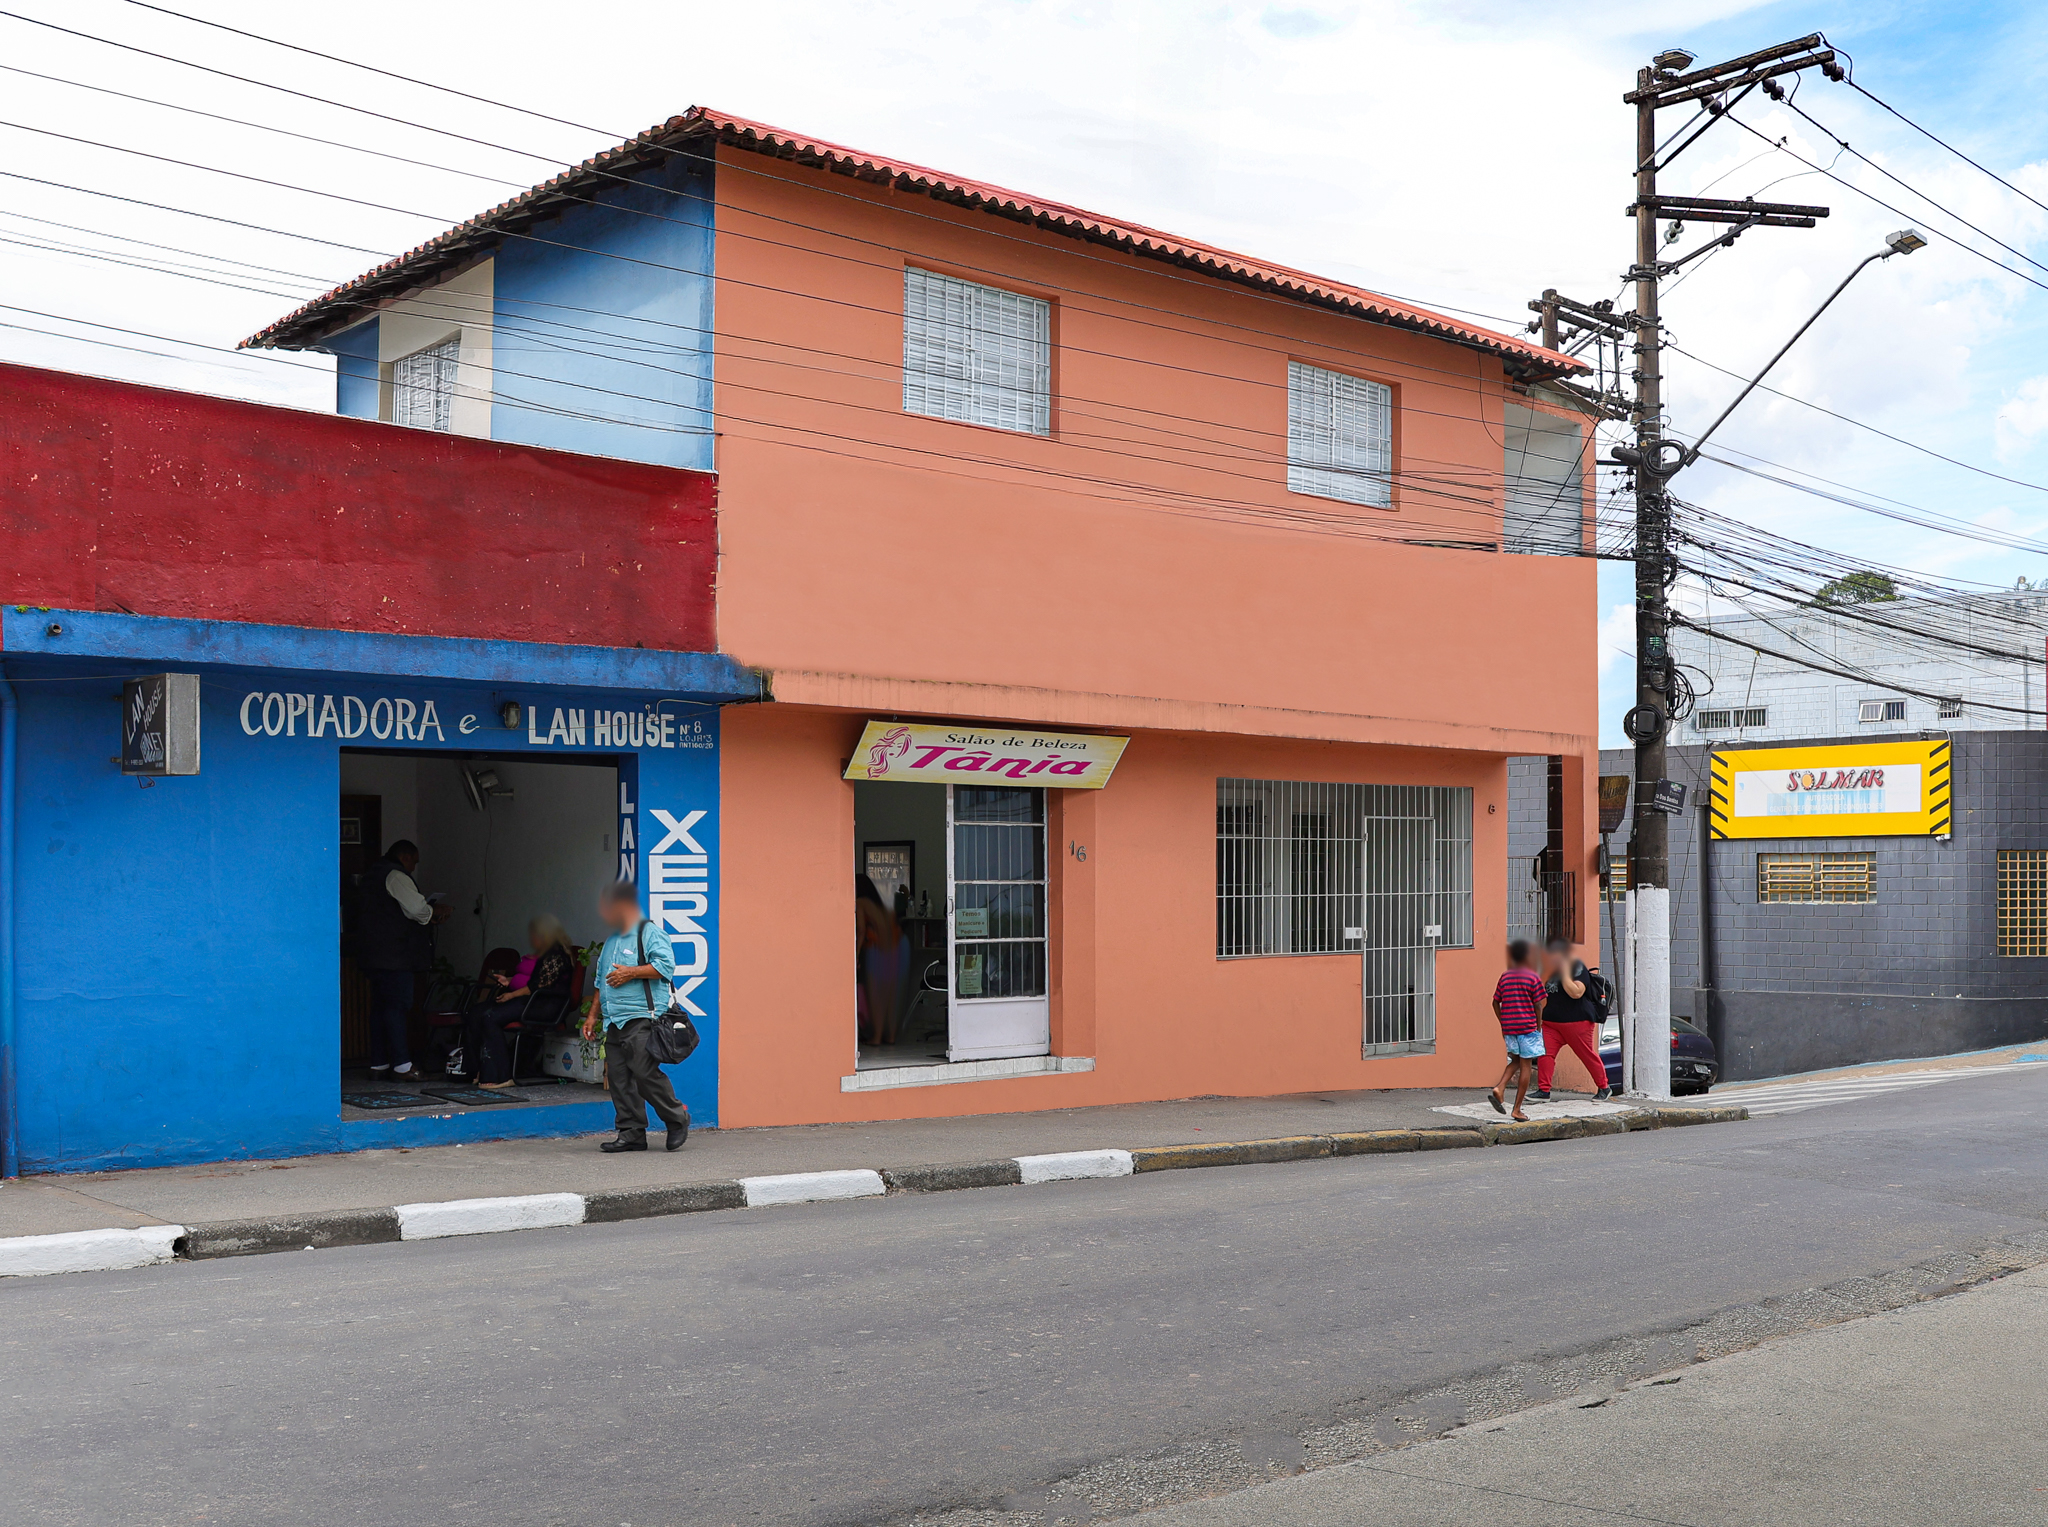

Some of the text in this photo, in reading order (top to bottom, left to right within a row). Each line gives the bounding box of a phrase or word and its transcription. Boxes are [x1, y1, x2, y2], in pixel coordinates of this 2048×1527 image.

[125, 684, 145, 746] LAN
[143, 680, 163, 731] HOUSE
[239, 691, 481, 742] COPIADORA e
[528, 705, 675, 748] LAN HOUSE
[693, 720, 702, 734] 8
[944, 733, 1087, 751] Salão de Beleza
[909, 745, 1093, 779] Tânia
[1786, 769, 1885, 792] SOLMAR
[1806, 793, 1846, 802] AUTO ESCOLA
[1068, 839, 1087, 863] 16
[648, 808, 709, 1017] XEROX
